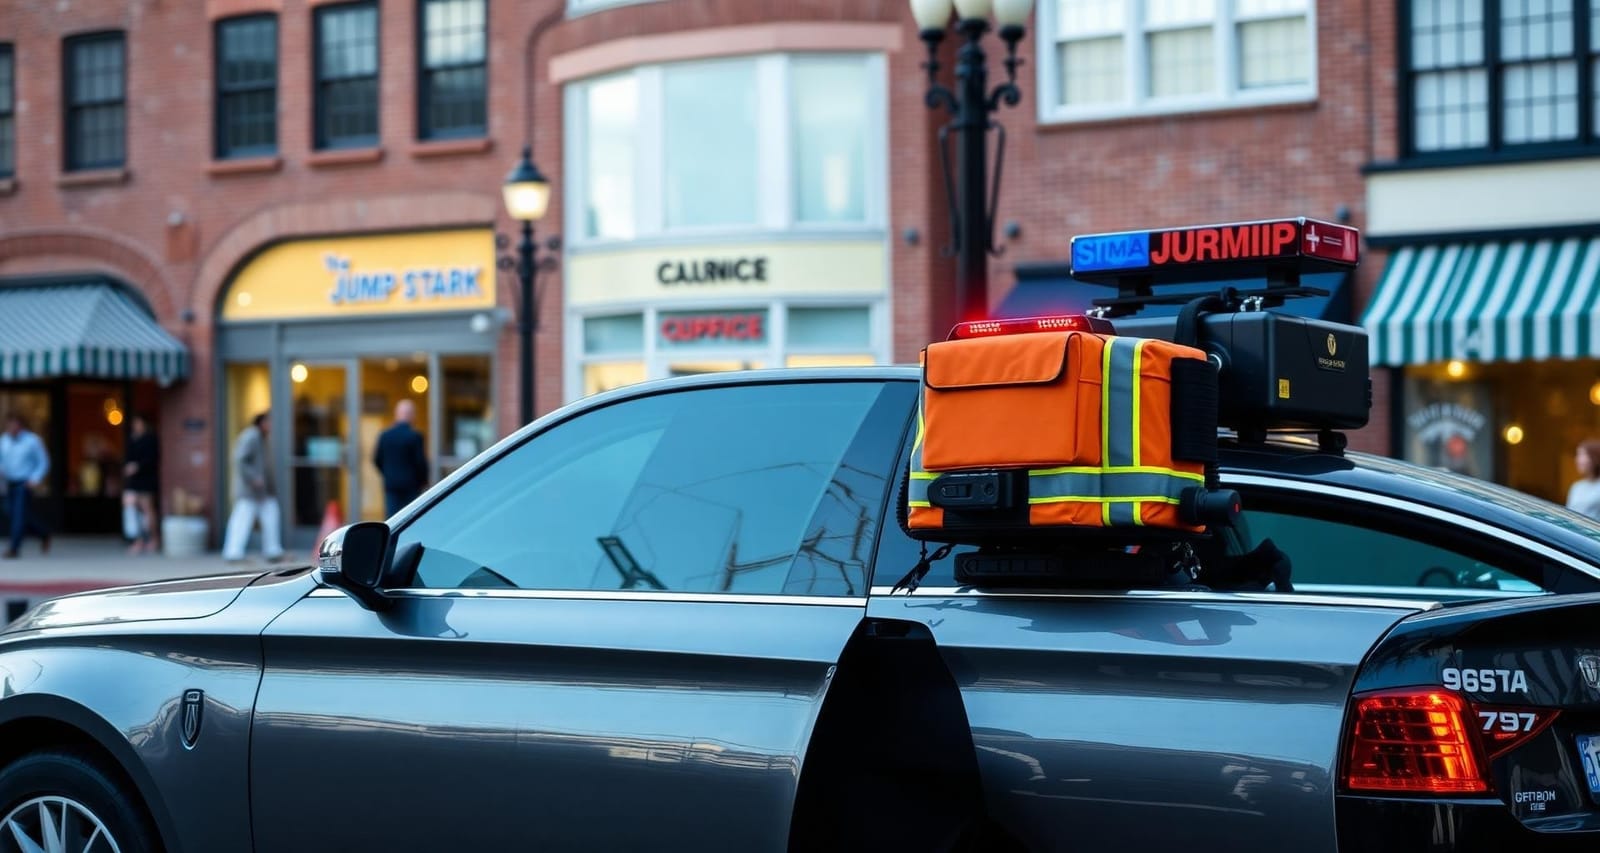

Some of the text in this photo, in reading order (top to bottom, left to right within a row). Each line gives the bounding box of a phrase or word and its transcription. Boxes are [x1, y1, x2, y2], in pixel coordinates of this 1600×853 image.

[331, 267, 483, 304] JUMP STARK
[1478, 711, 1537, 732] 797
